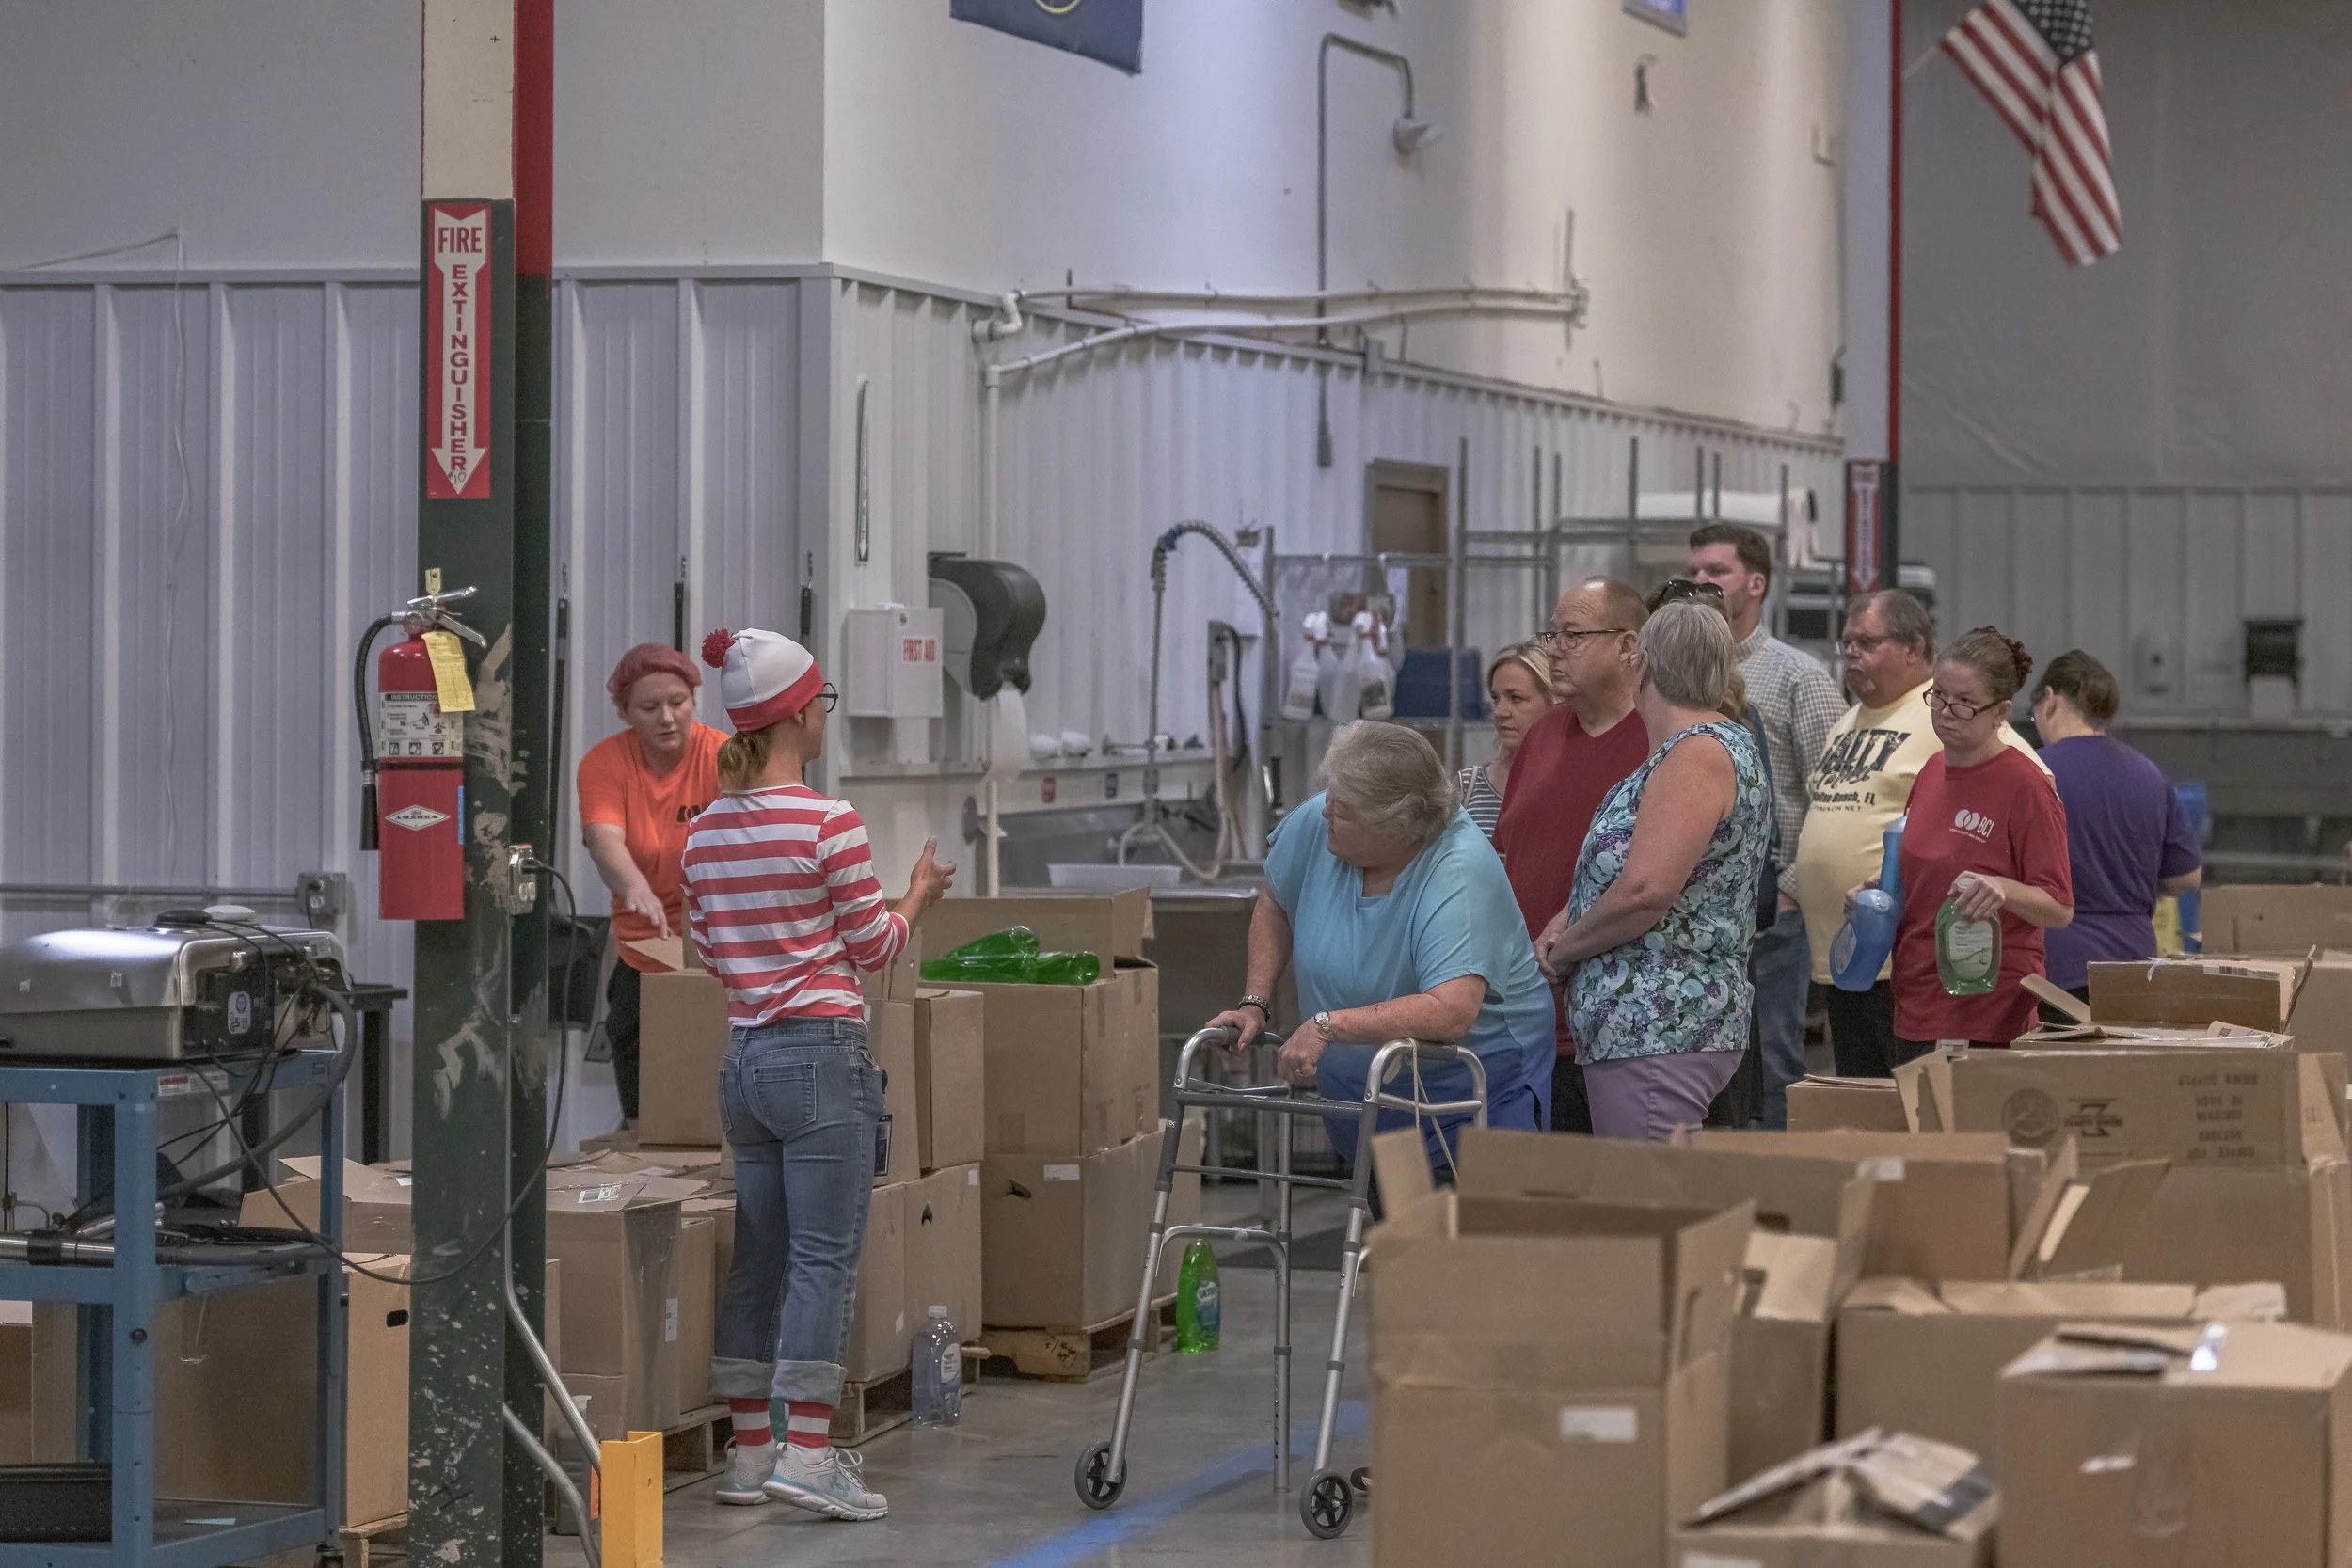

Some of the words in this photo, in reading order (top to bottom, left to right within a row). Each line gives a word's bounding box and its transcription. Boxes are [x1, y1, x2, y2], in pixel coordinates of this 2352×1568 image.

[437, 226, 483, 254] FIRE
[450, 263, 469, 471] EXTINGUISHER
[902, 639, 922, 662] FIRST
[923, 639, 936, 662] AID
[1813, 729, 1912, 773] ALTY
[1864, 792, 1876, 806] FL
[1977, 816, 1995, 838] BCI
